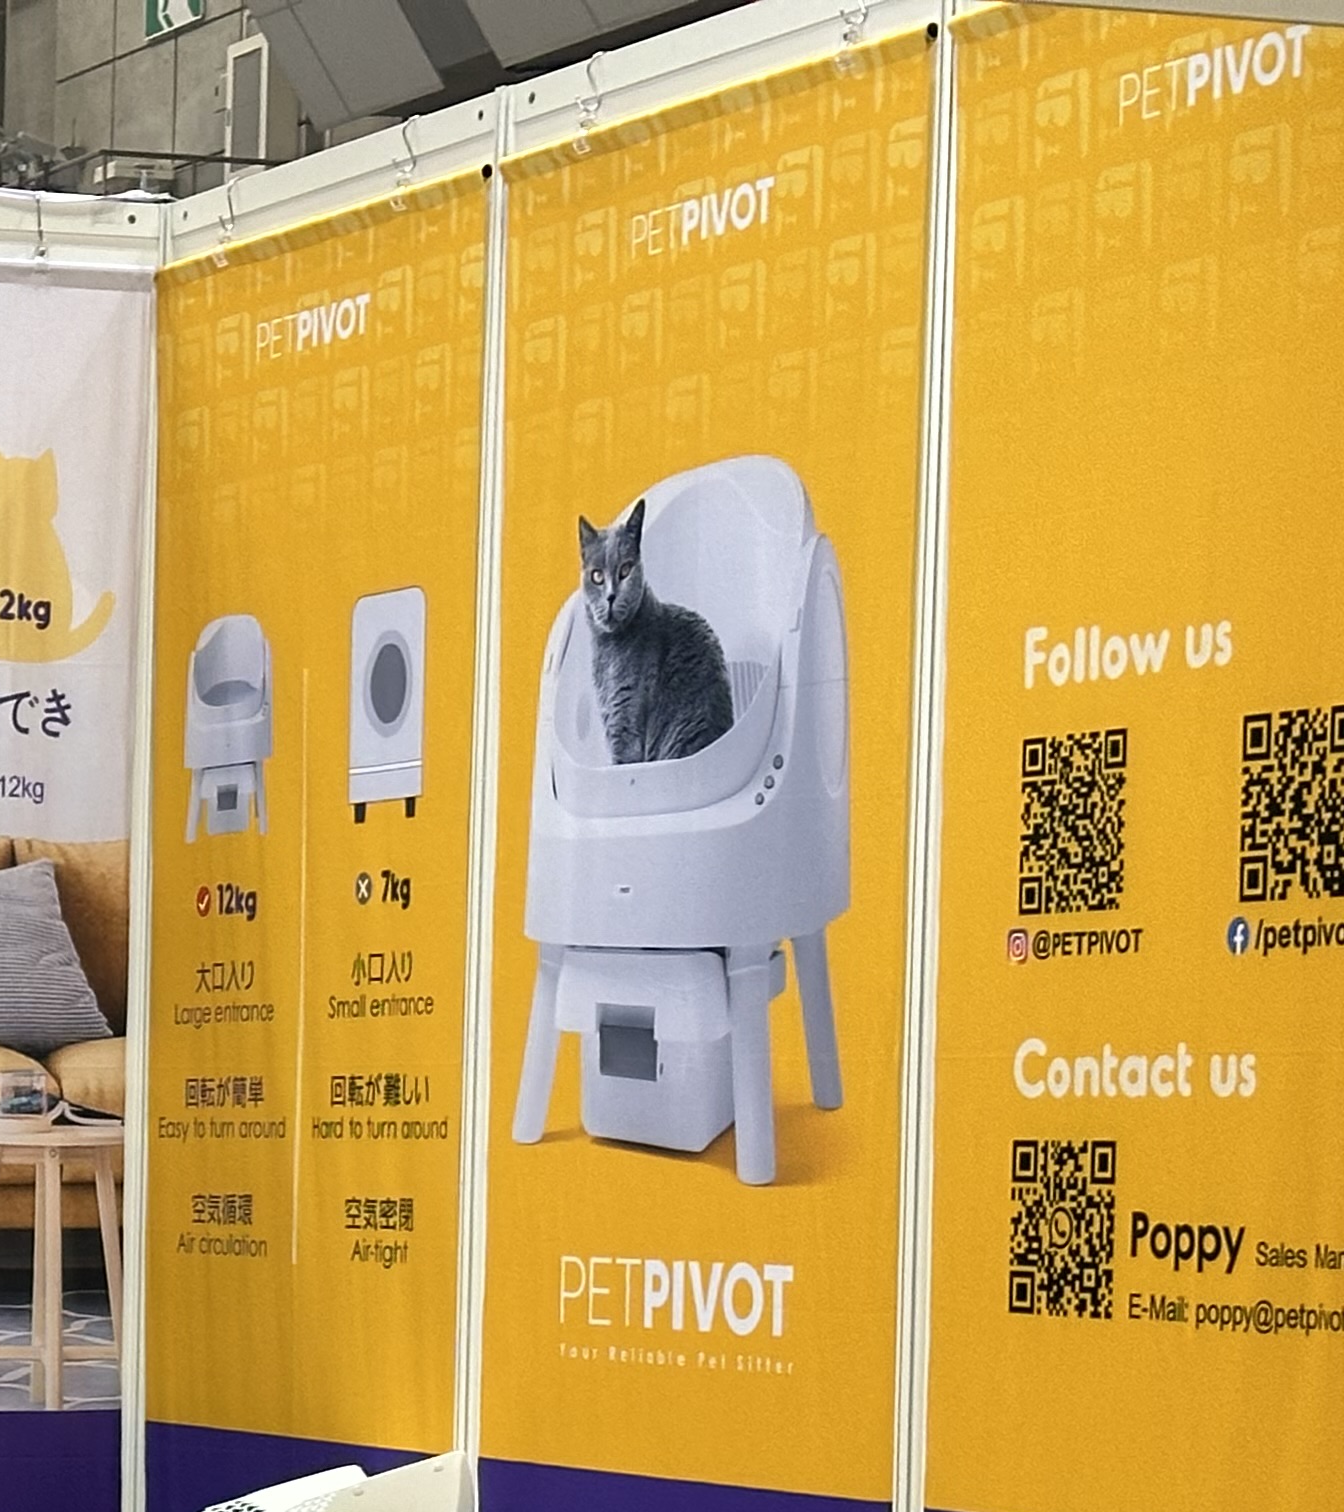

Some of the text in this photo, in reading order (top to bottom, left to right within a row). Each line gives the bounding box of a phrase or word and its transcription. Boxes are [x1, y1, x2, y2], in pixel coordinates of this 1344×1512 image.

[1117, 25, 1312, 128] PETPIVOT
[630, 176, 775, 261] PETPIVOT
[255, 293, 372, 364] PETPIVOT
[1023, 619, 1232, 690] Follow us
[216, 883, 258, 921] 12kg
[380, 870, 412, 909] 7kg
[1032, 928, 1143, 961] @PETPIVOT
[194, 960, 255, 993] 大口入り
[351, 951, 413, 986] 小口入り
[174, 1003, 275, 1030] Large entrance
[327, 994, 435, 1019] Small entrance
[1013, 1037, 1257, 1099] Contact us
[183, 1076, 265, 1108] 回転が簡単
[330, 1074, 430, 1107] 回転が難しい
[158, 1117, 286, 1143] Easy to turn around
[312, 1118, 448, 1140] Hard to turn around
[191, 1193, 253, 1225] 空気循環
[344, 1196, 415, 1232] 空気密閉
[176, 1233, 268, 1259] Air circulation
[351, 1240, 409, 1269] Air-tight
[1130, 1211, 1246, 1274] Poppy
[1256, 1242, 1308, 1269] Sales
[559, 1255, 794, 1338] PETPIVOT
[559, 1343, 794, 1375] Your Reliable Pet Sitter
